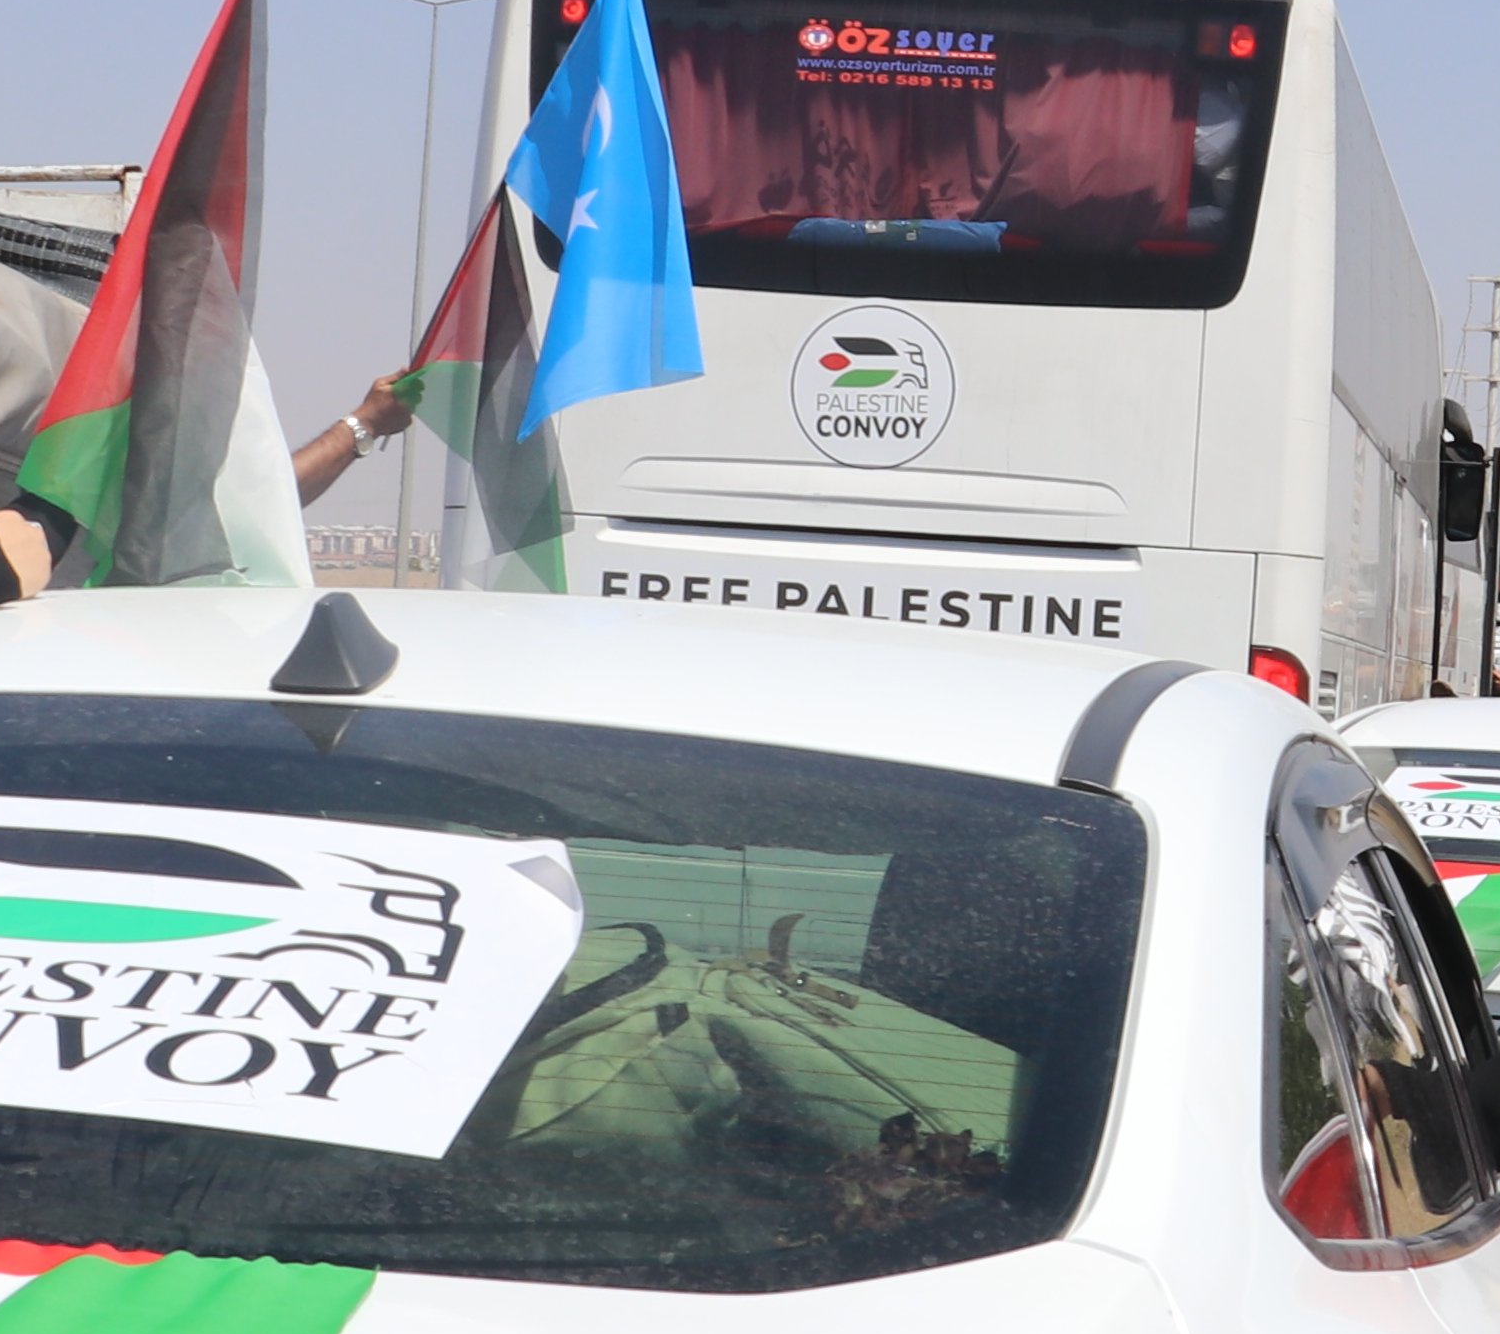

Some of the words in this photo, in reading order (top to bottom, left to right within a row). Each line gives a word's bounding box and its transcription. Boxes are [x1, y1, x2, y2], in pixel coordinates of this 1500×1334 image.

[837, 20, 891, 54] ÖZ
[896, 29, 994, 57] soyer
[797, 57, 995, 76] www.ozsoyerturizm.com.tr
[796, 69, 833, 83] Tel:
[839, 72, 889, 85] 0216
[895, 74, 933, 87] 589
[940, 76, 963, 89] 13
[970, 78, 994, 90] 13
[816, 393, 928, 413] PALESTINE
[816, 415, 927, 439] CONVOY
[776, 581, 1123, 640] PALESTINE
